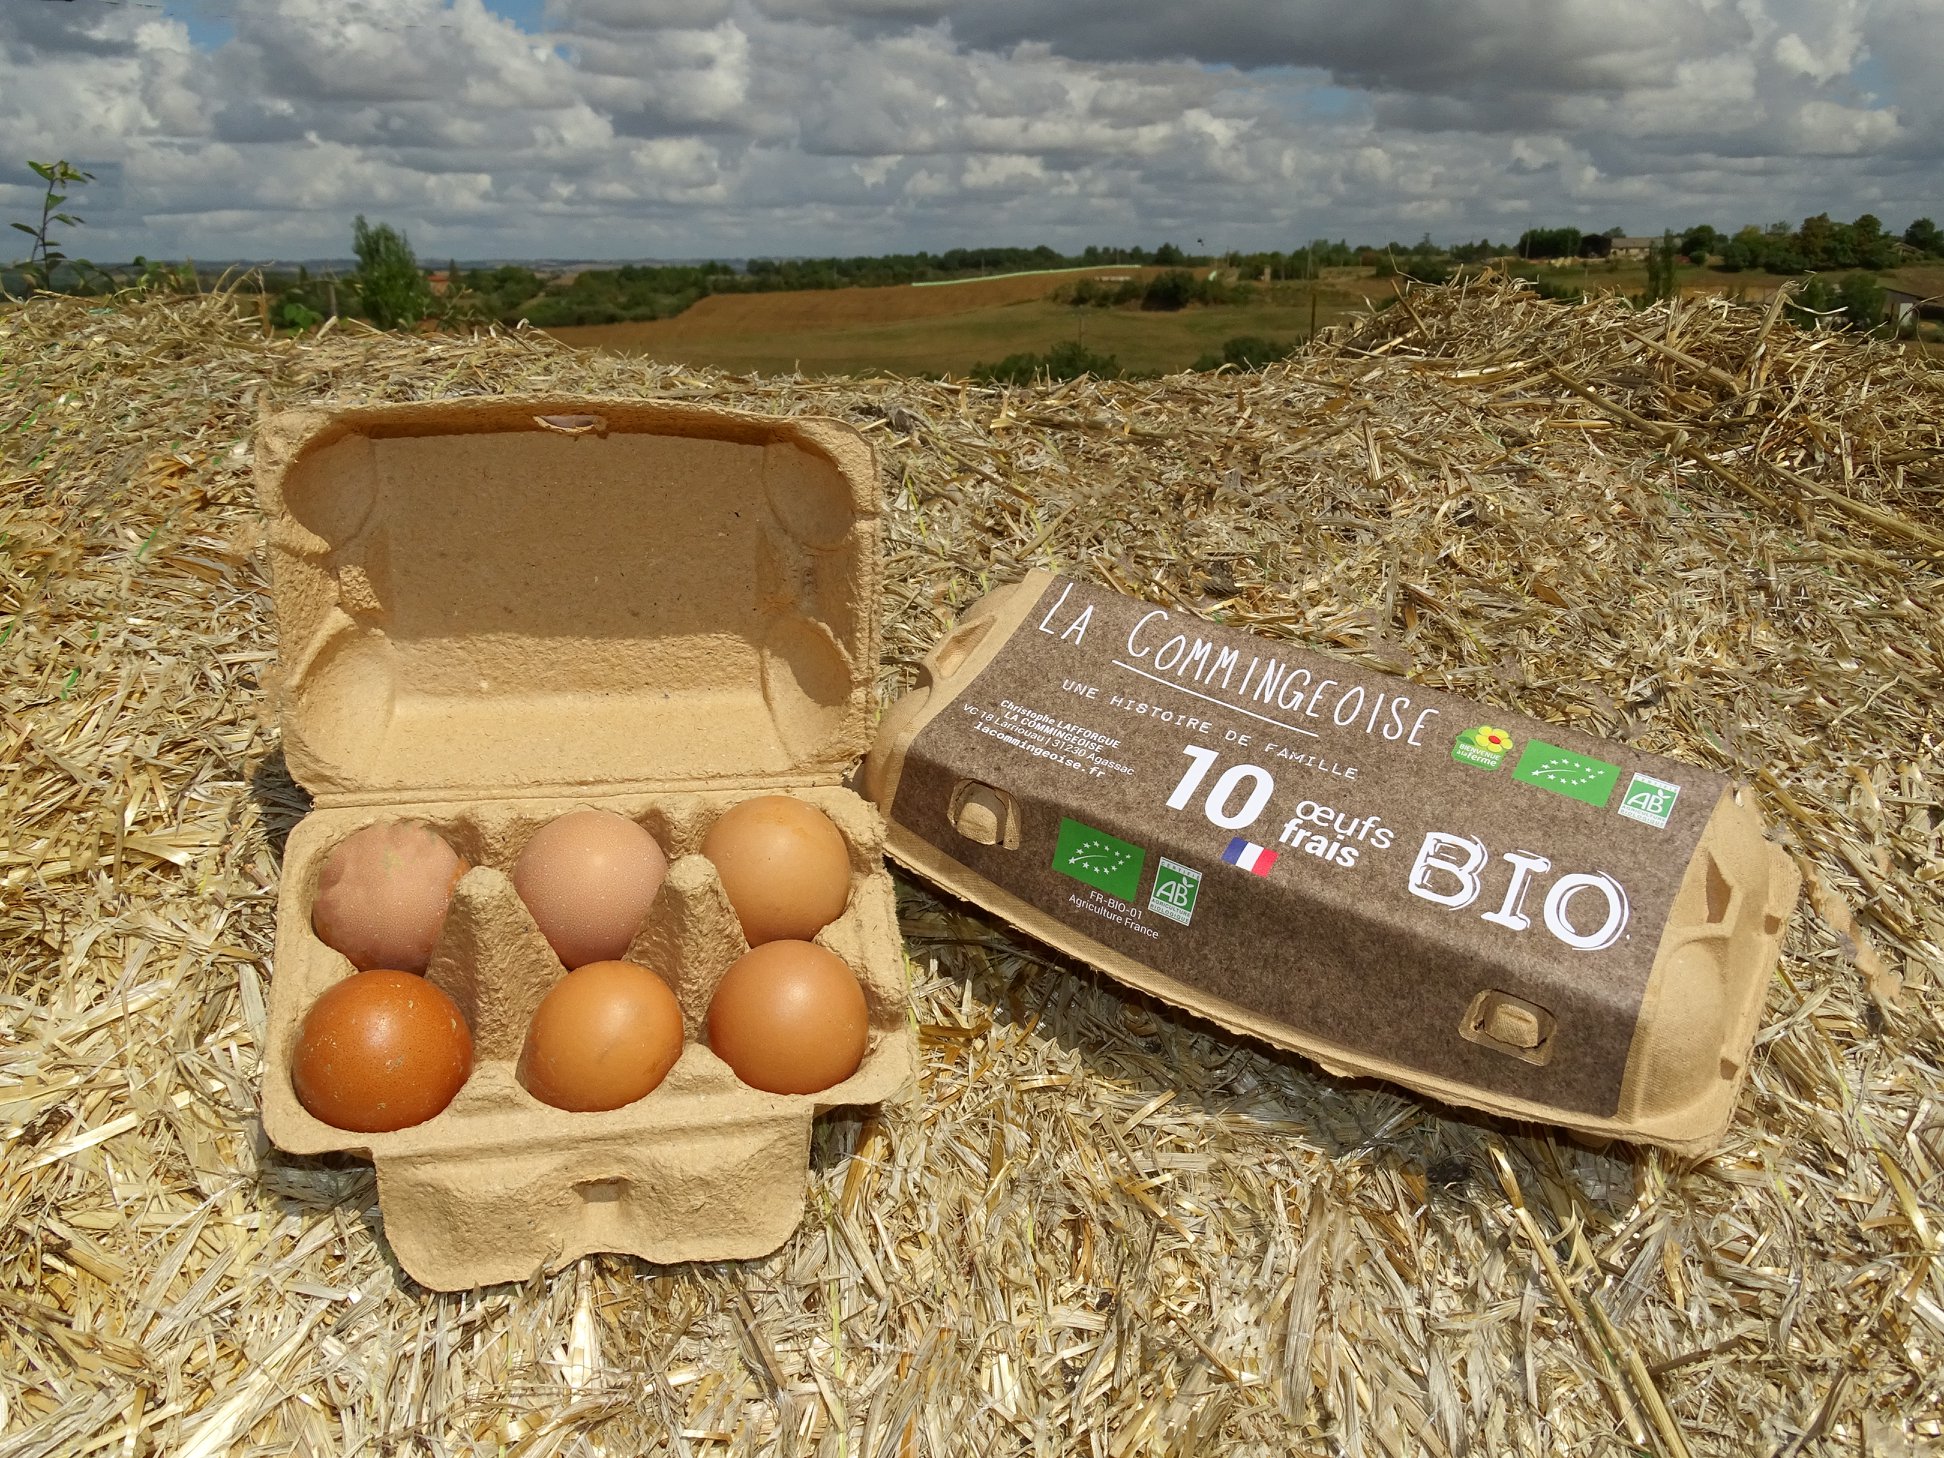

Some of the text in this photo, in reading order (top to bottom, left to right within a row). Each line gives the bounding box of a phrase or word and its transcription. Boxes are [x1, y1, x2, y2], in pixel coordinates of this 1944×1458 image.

[1039, 582, 1439, 747] LA COMMINGEOISE
[963, 704, 979, 715] VC
[981, 711, 994, 721] 18
[995, 716, 1044, 742] Larriouau
[1052, 739, 1086, 757] 31230
[1087, 752, 1135, 776] Agassac
[1001, 700, 1122, 749] Christophe LAFFORGUE
[1004, 711, 1103, 753] LA COMMINGEOISE
[1062, 679, 1358, 779] UNE HISTOIRE DE FAMILLE
[974, 721, 1106, 778] lacommingeoise.fr
[1460, 743, 1501, 761] BIENVENUE
[1467, 752, 1497, 767] ferme
[1165, 744, 1274, 830] 10
[1627, 792, 1664, 814] AB
[1279, 821, 1360, 868] frais
[1089, 890, 1142, 920] FR-BIO-01
[1156, 880, 1188, 907] AB
[1407, 831, 1631, 951] BIO
[1068, 894, 1159, 940] Agriculture France
